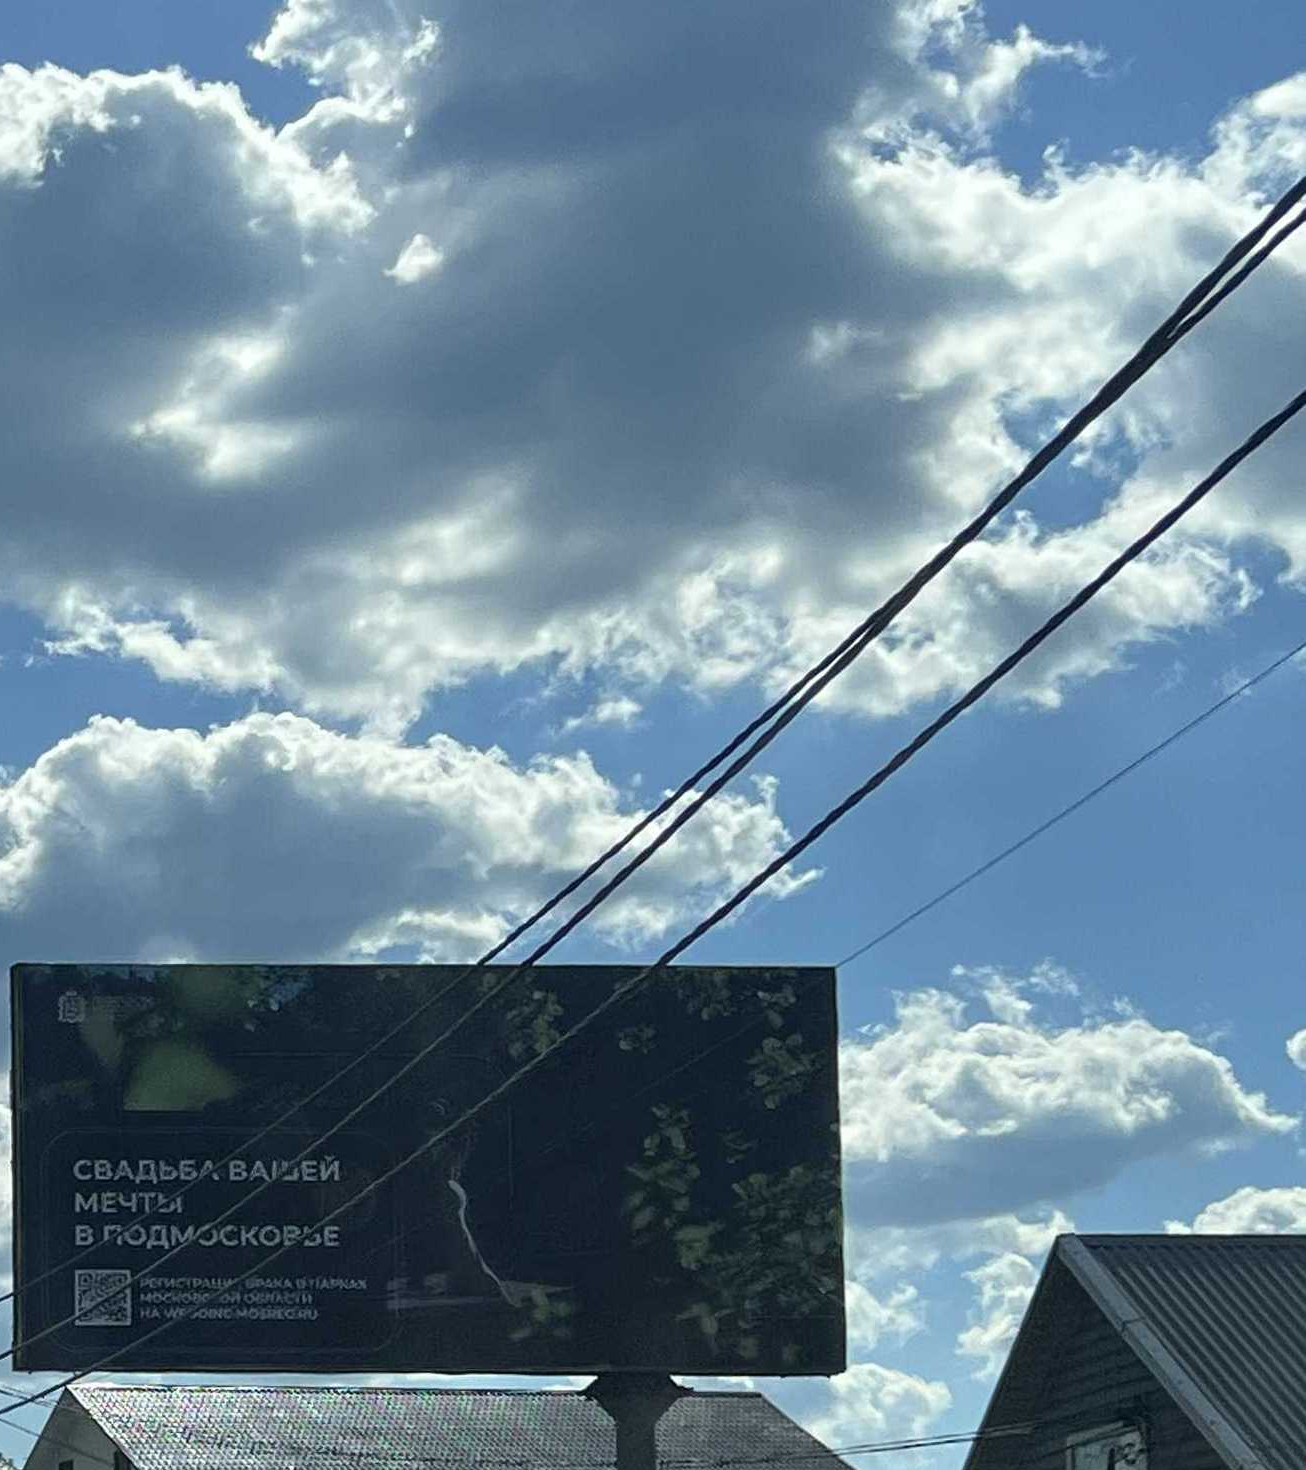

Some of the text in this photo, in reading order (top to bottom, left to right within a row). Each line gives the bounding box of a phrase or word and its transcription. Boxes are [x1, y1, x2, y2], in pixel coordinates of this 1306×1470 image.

[73, 1155, 341, 1184] СВАДЬБА ВАШЕЙ
[74, 1191, 184, 1213] МЕЧТЫ
[74, 1224, 341, 1250] В ПОДМОСКОВЬЕ
[139, 1277, 241, 1291] РЕГИСТРАЦИ
[139, 1292, 241, 1305] МОСКОВСОЙ
[139, 1307, 161, 1320] НА
